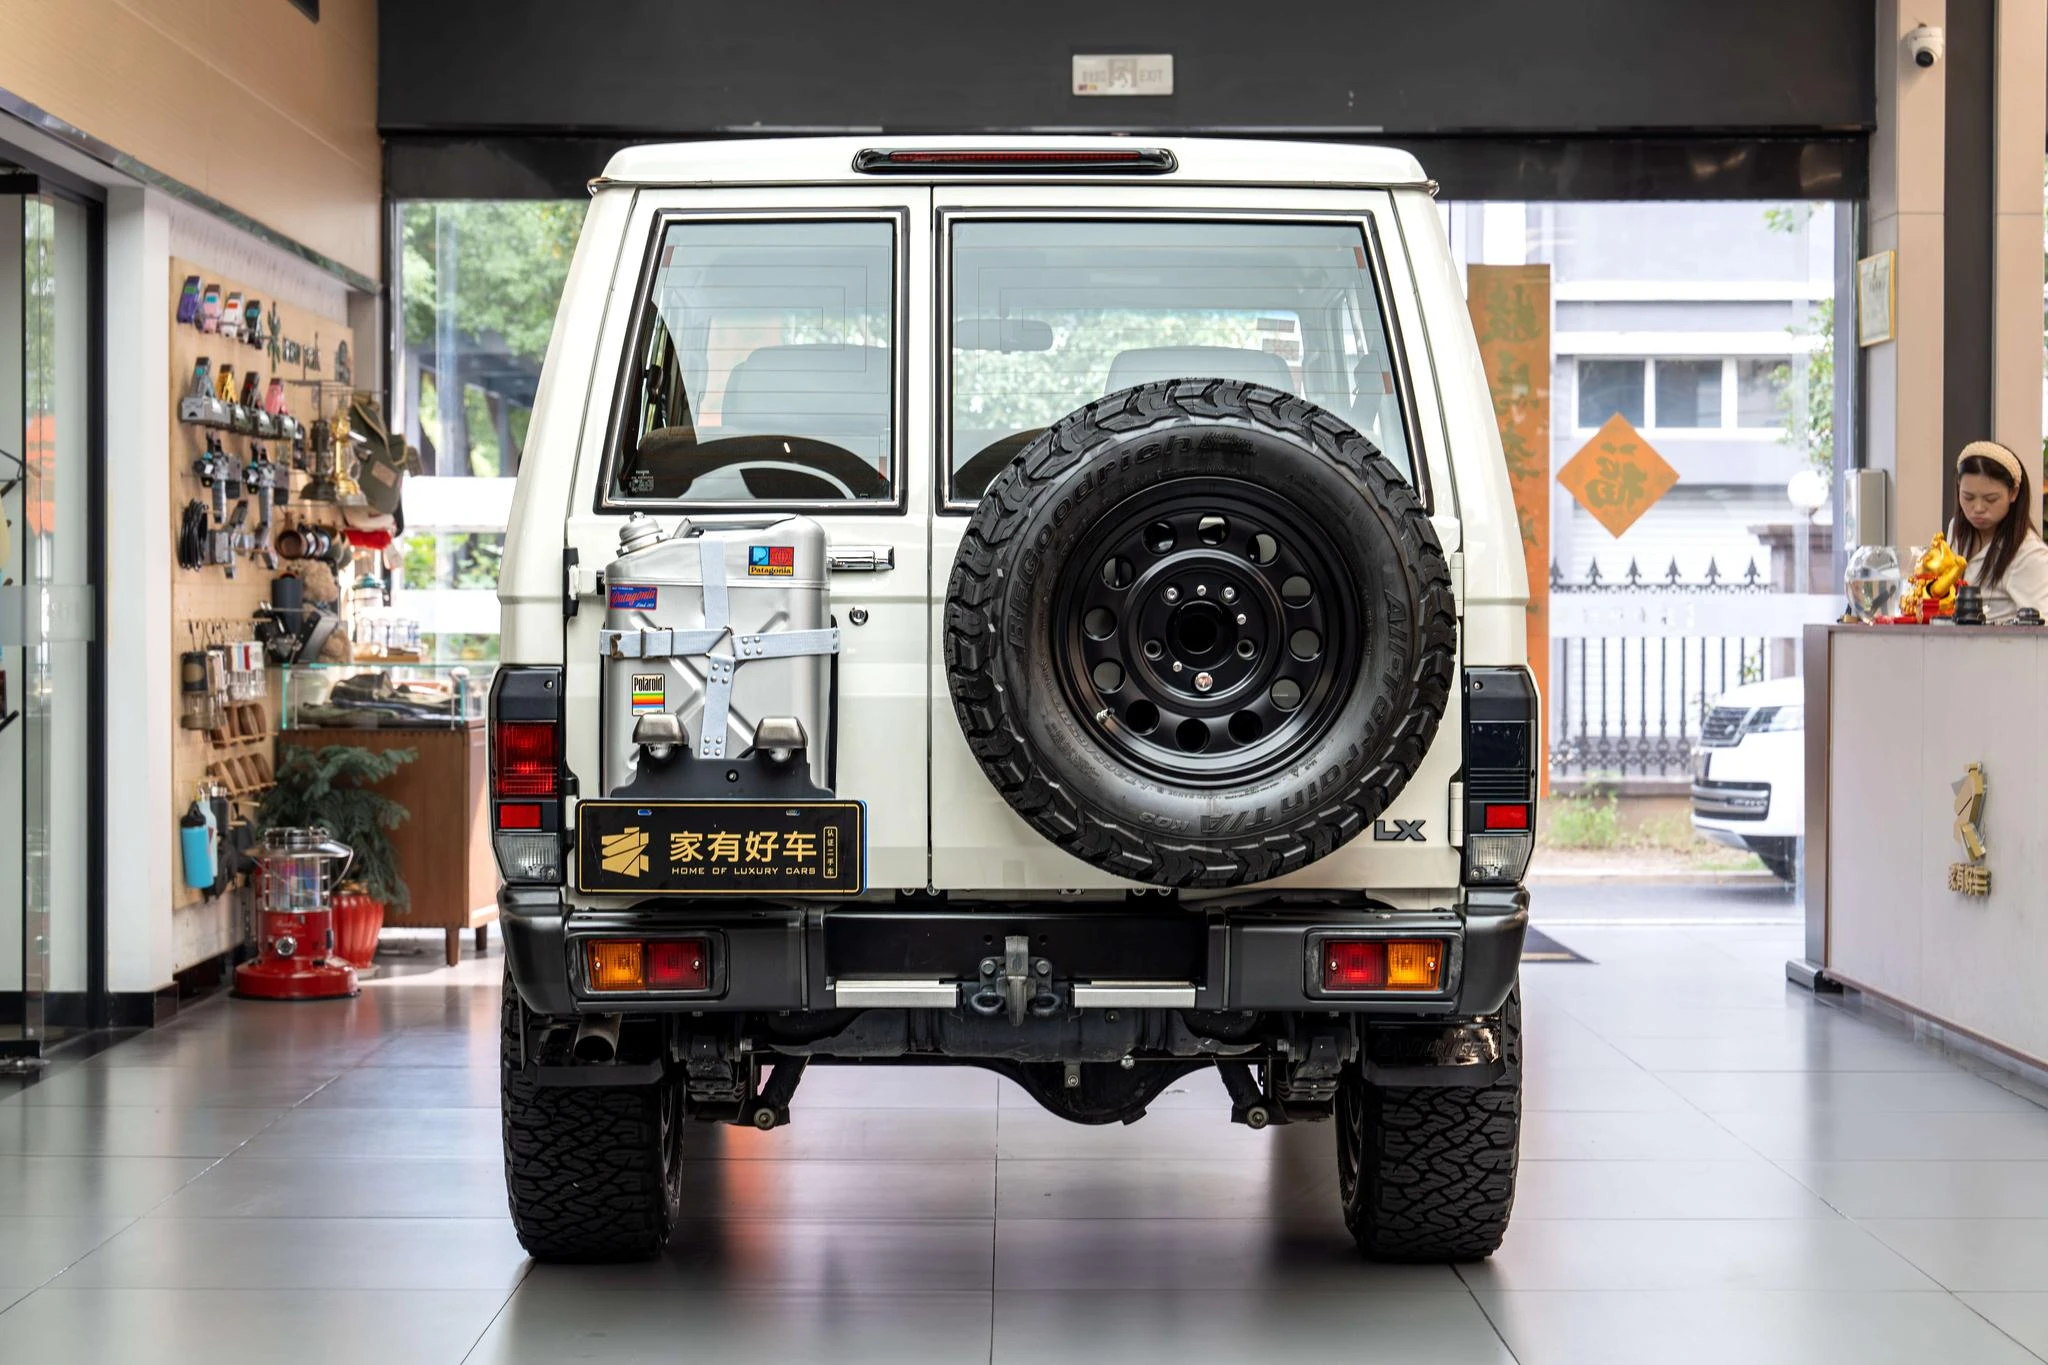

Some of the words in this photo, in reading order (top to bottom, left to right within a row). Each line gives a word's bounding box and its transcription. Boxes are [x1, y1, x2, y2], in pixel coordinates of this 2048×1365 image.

[1138, 69, 1164, 83] EXIT
[751, 566, 791, 576] Patagonia
[634, 676, 662, 691] Polaroid
[1374, 819, 1427, 841] LX
[670, 830, 817, 863] 家有好车
[671, 867, 705, 875] HOME
[712, 867, 728, 875] OF
[734, 867, 779, 875] LUXURY
[785, 867, 816, 875] CARS
